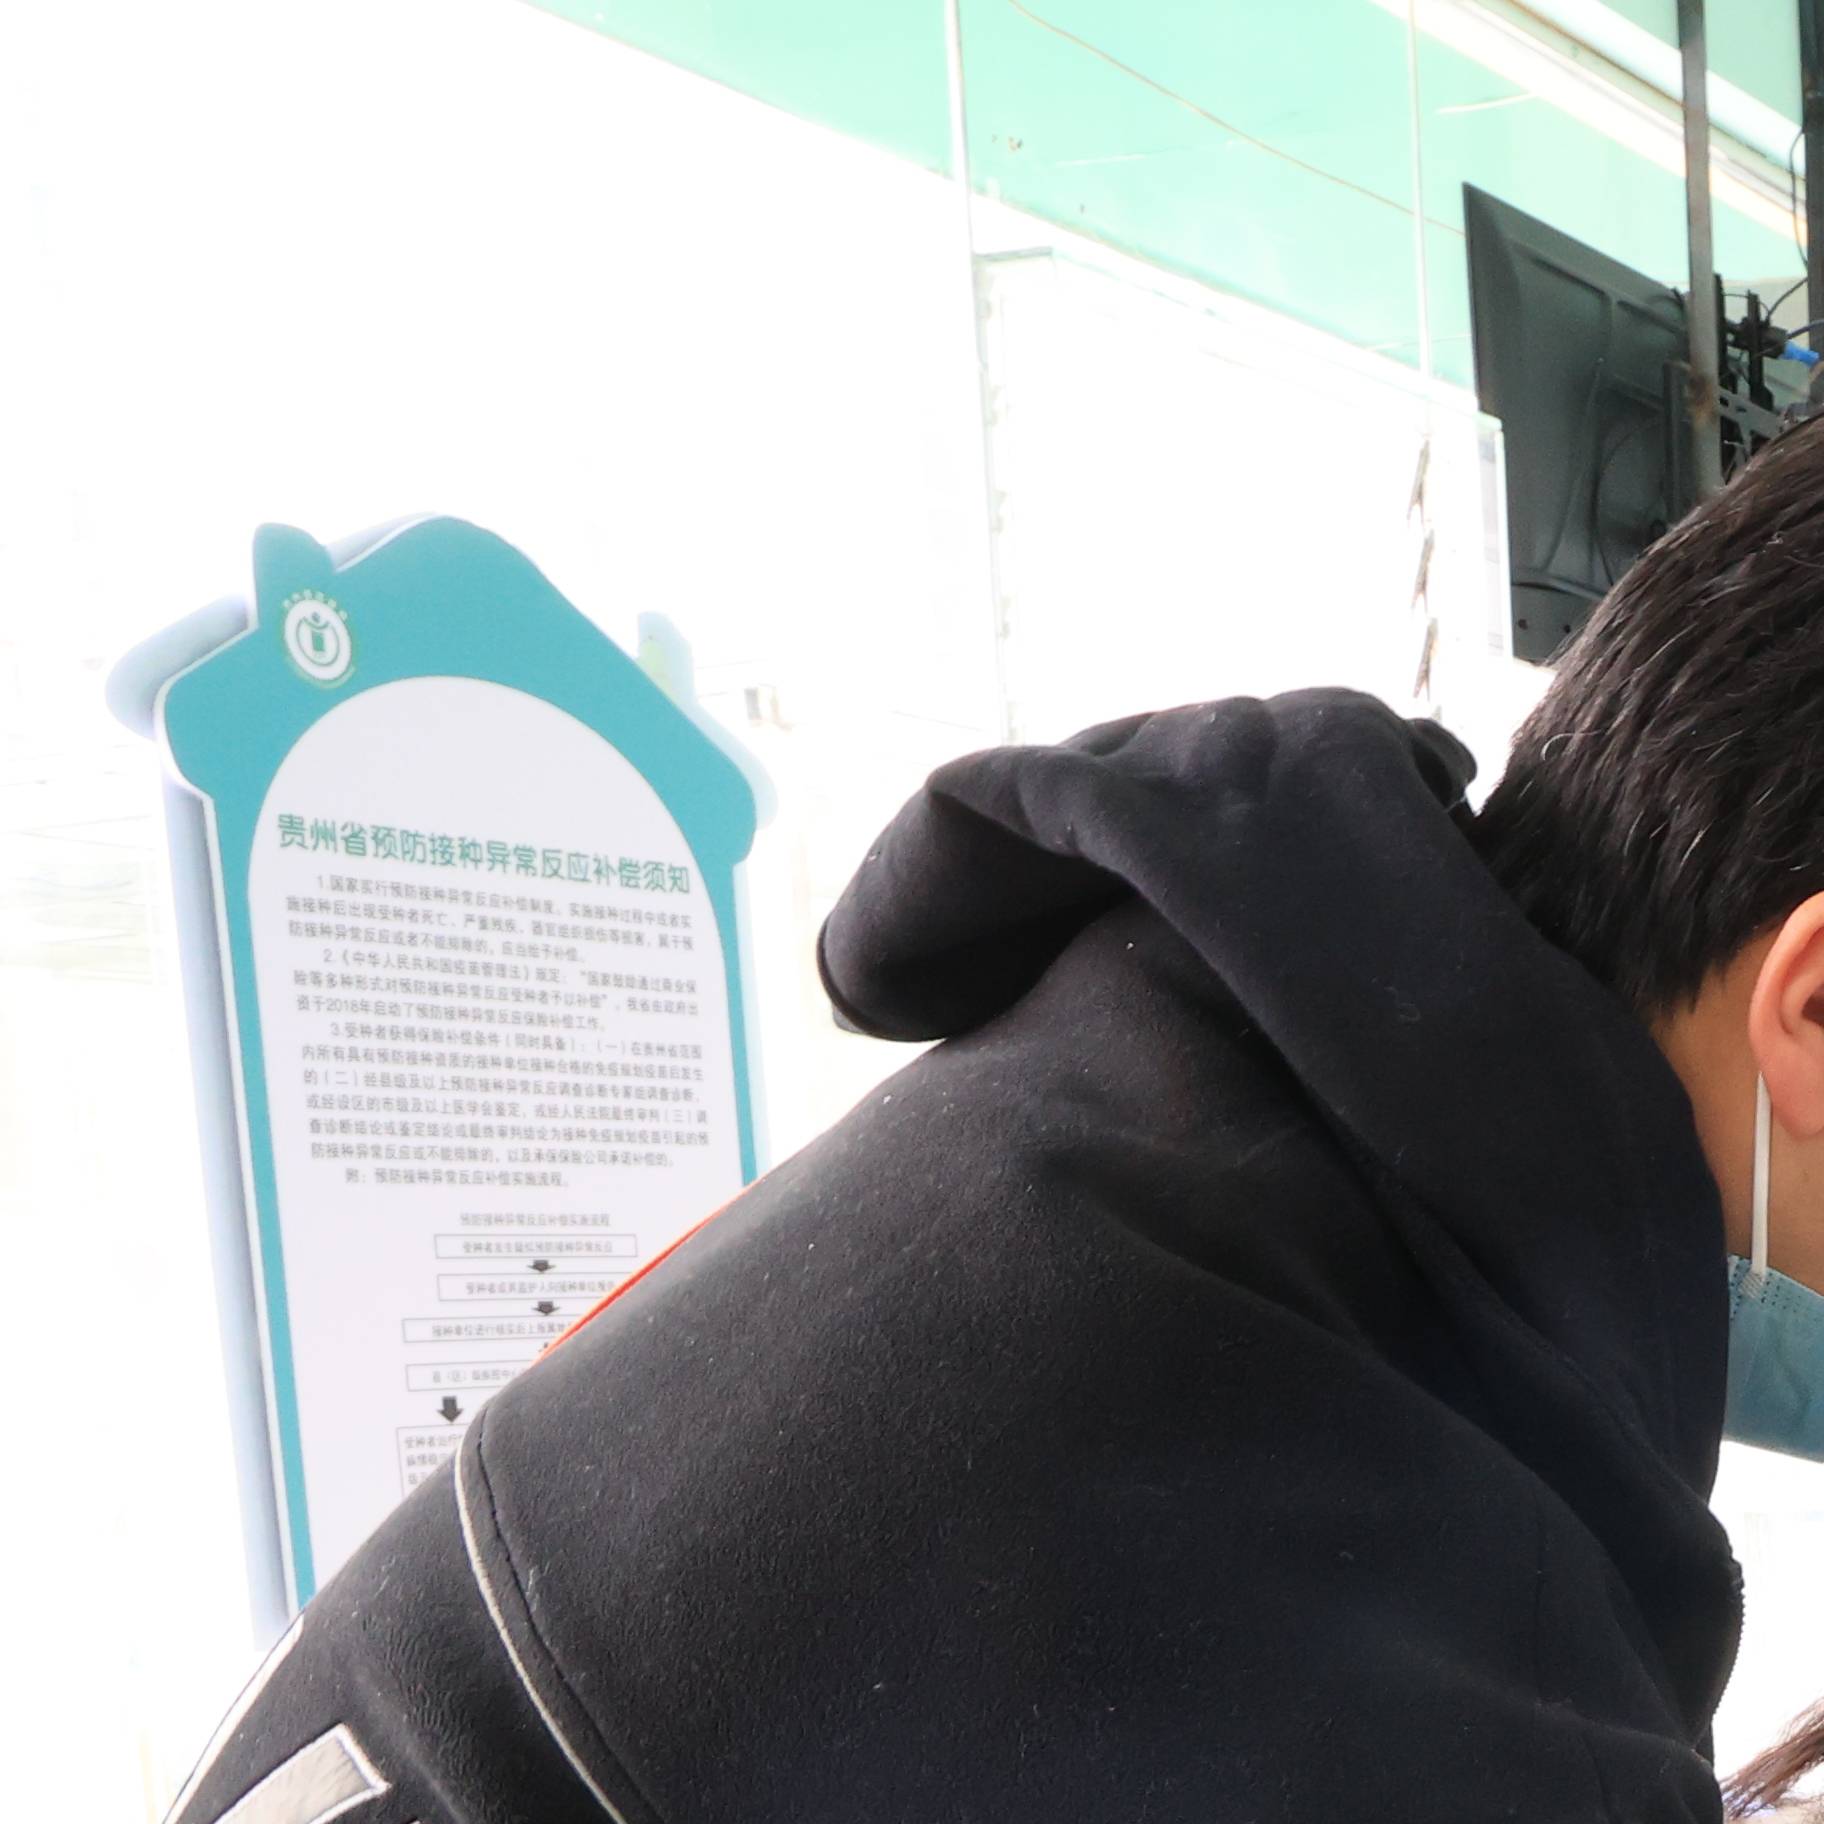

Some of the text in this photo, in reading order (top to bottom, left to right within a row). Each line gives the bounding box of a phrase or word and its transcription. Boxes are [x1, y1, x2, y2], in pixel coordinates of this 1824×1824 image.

[277, 812, 691, 893] 贵州省预防接种异常反应补偿须知
